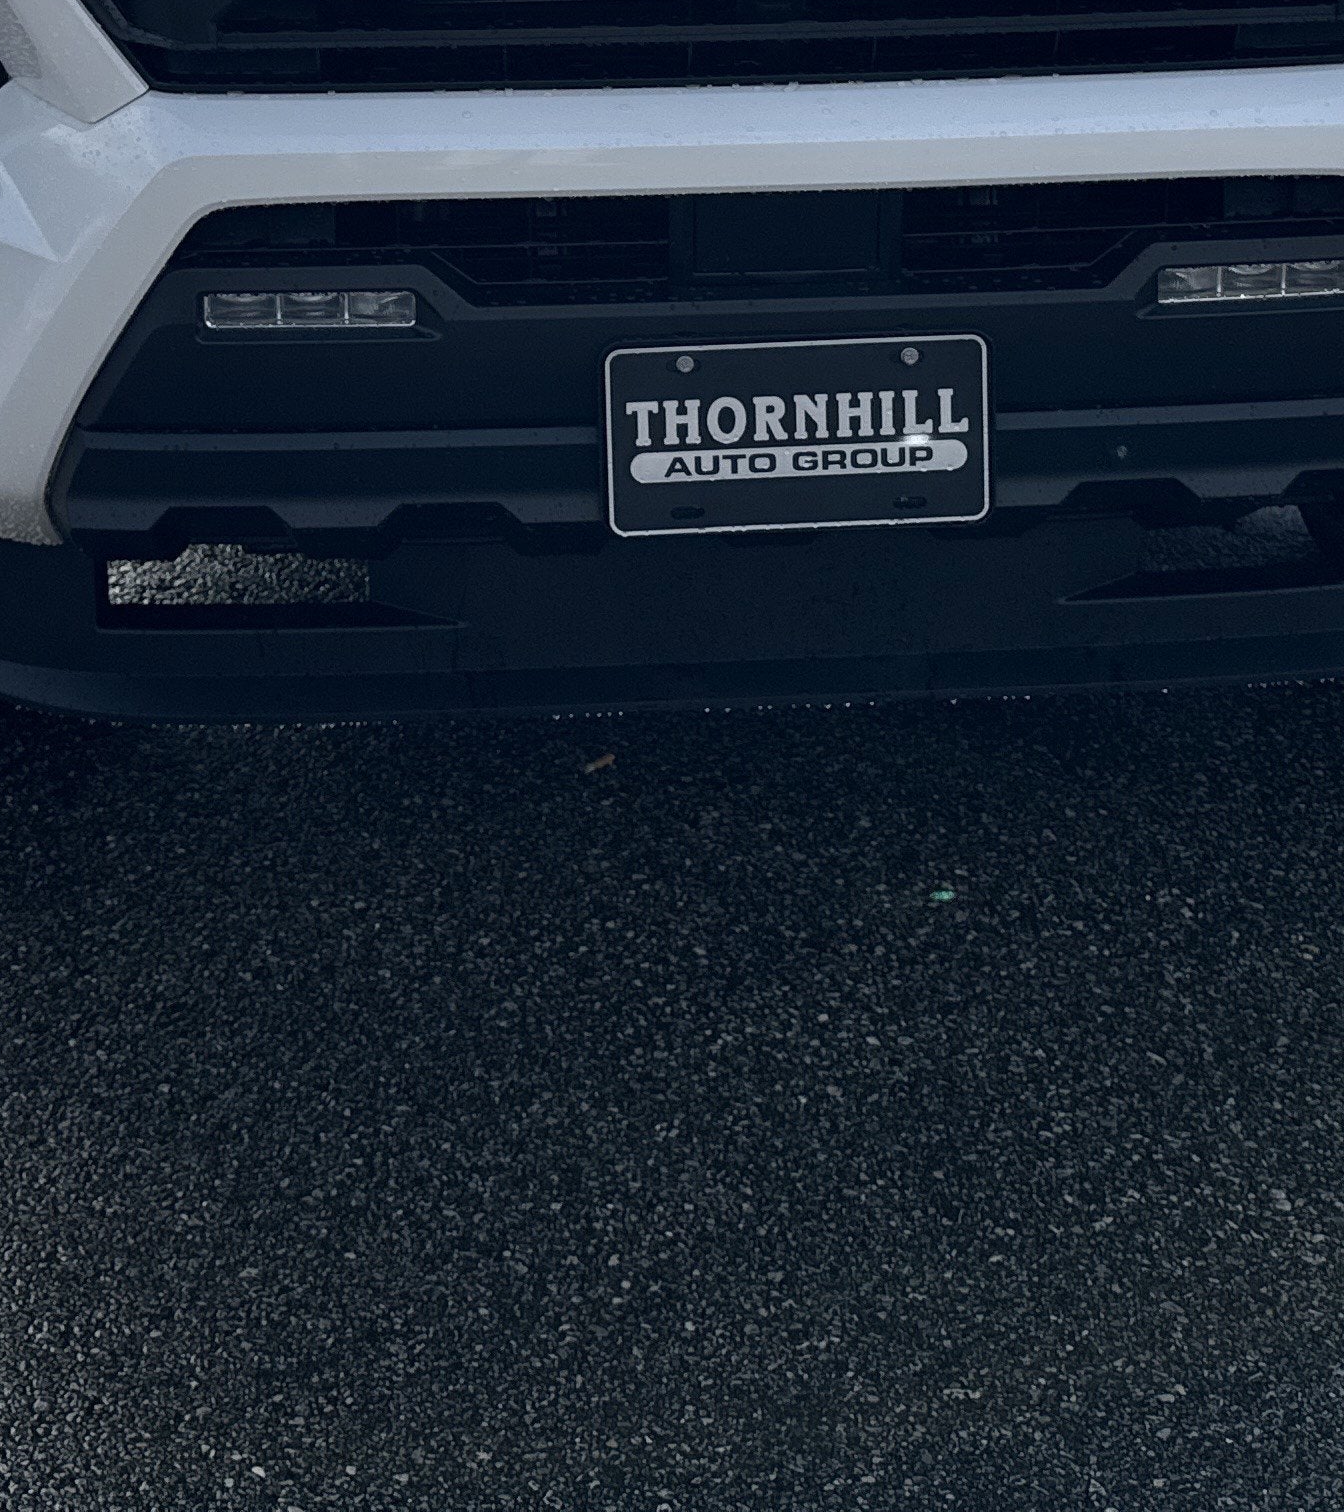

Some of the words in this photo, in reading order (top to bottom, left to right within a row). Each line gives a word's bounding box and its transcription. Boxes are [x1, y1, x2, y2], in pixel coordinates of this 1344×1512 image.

[625, 388, 969, 447] THORNHILL
[664, 452, 777, 478] AUTO
[792, 445, 935, 472] GROUP
